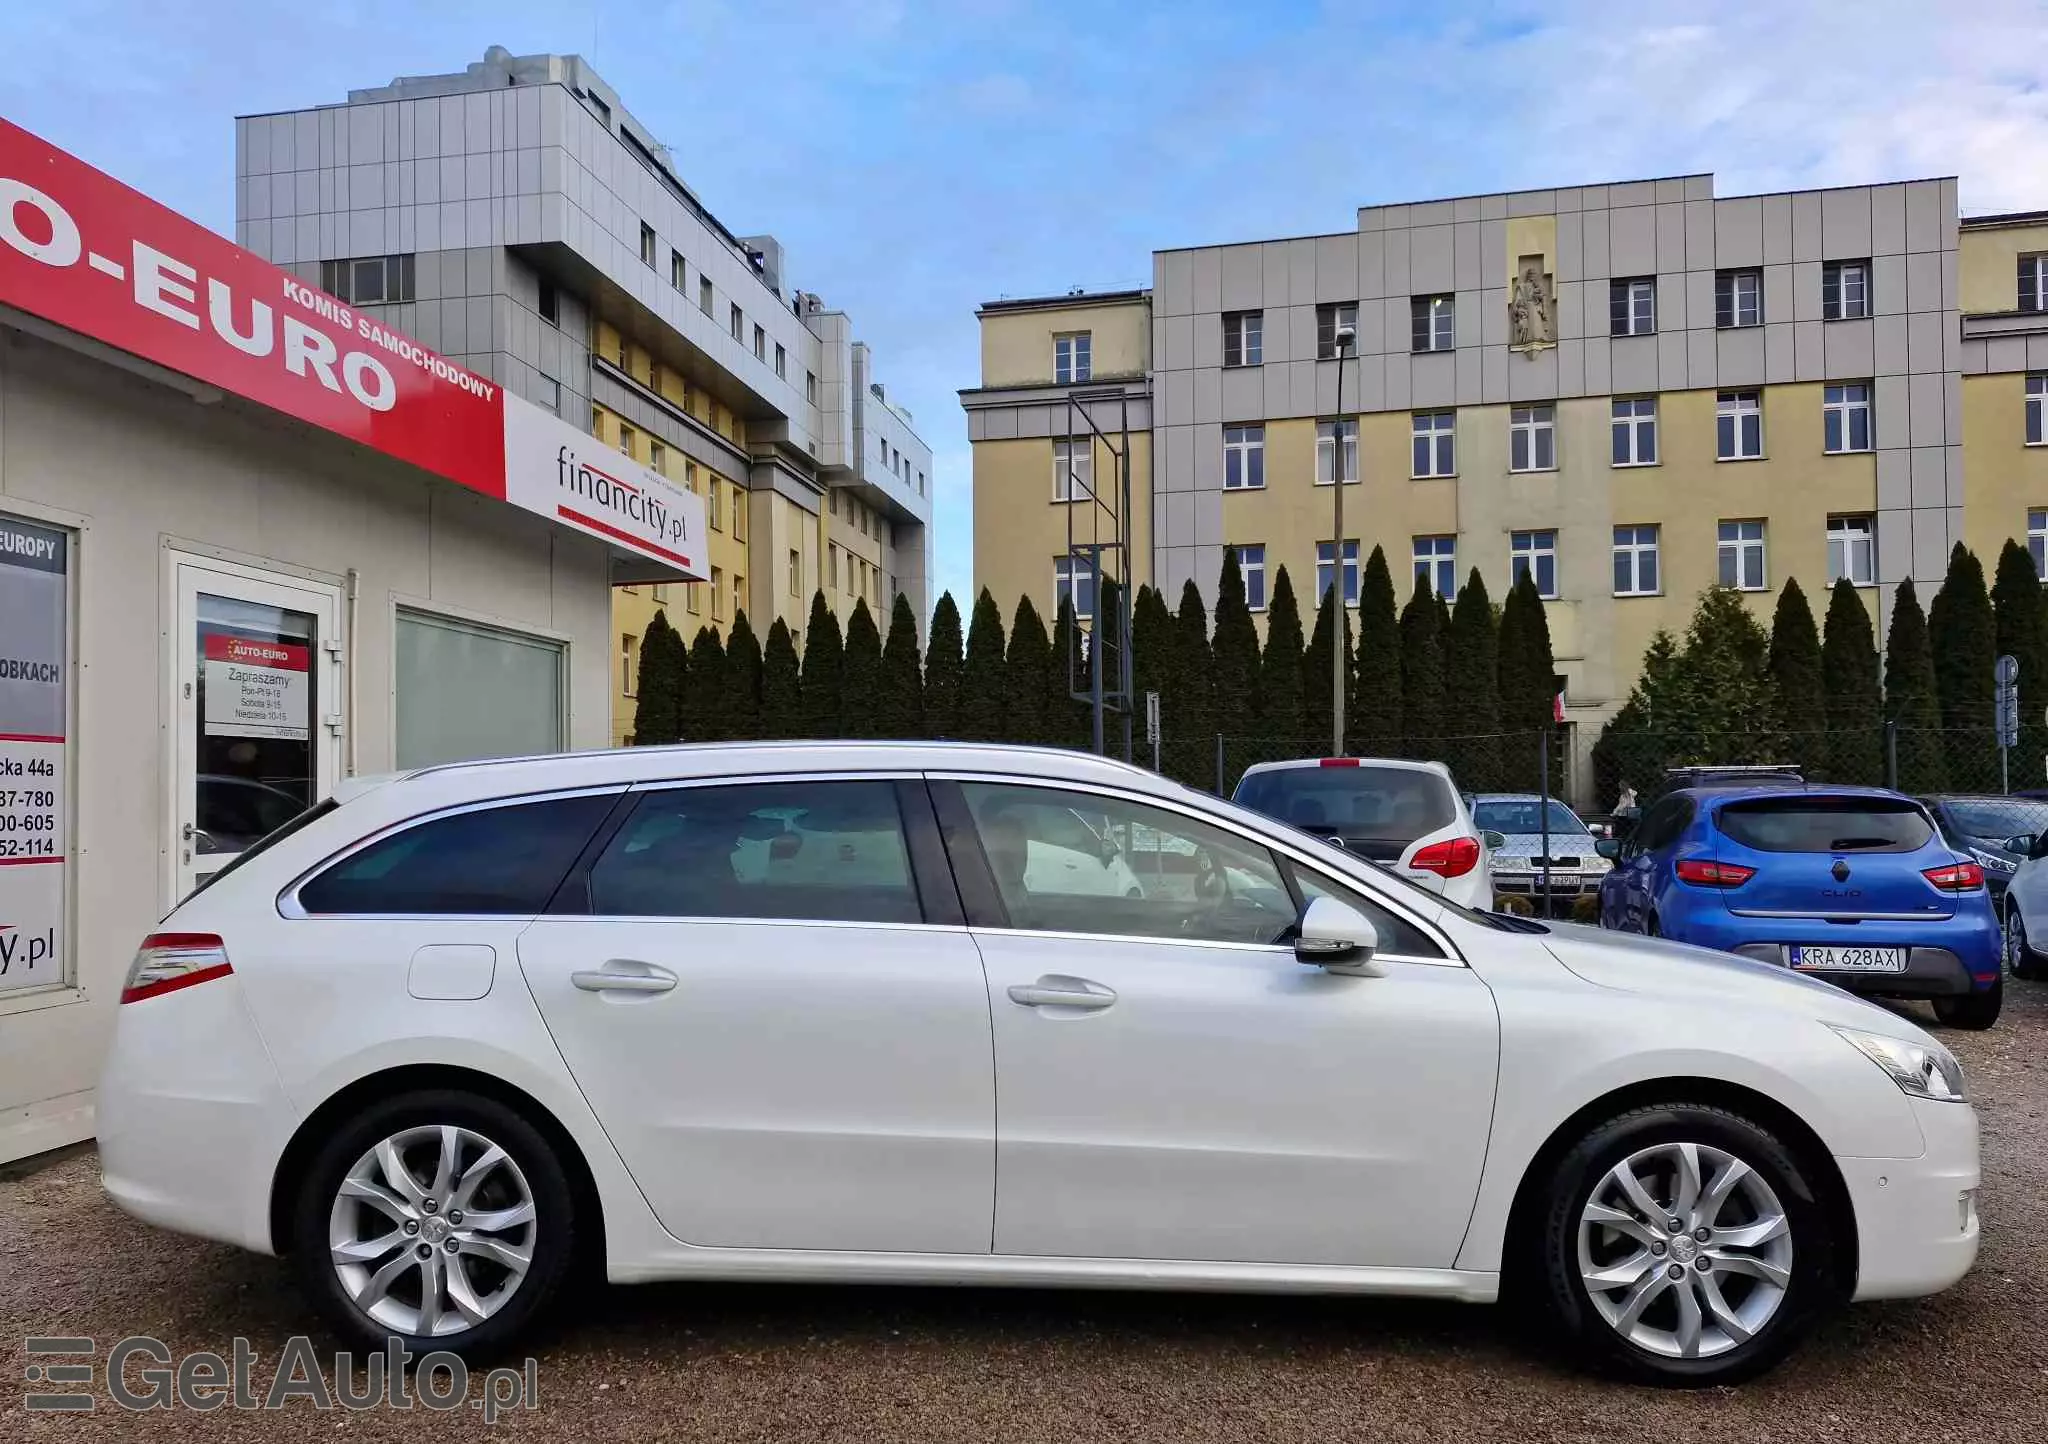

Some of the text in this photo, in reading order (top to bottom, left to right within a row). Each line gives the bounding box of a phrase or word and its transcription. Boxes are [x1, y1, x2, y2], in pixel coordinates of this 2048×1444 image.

[0, 178, 396, 412] O-EURO
[284, 278, 494, 402] KOMIS SAMOCHODOWY
[557, 445, 687, 544] financity.pl
[234, 644, 288, 660] AUTO-EURO
[0, 659, 59, 683] OBKACH
[229, 667, 289, 688] Zapraszamy
[28, 759, 54, 776] 44a
[0, 838, 54, 856] 52-114
[1821, 889, 1861, 897] CLIO
[0, 927, 53, 975] y.pl
[1801, 948, 1895, 966] KRA 628AX
